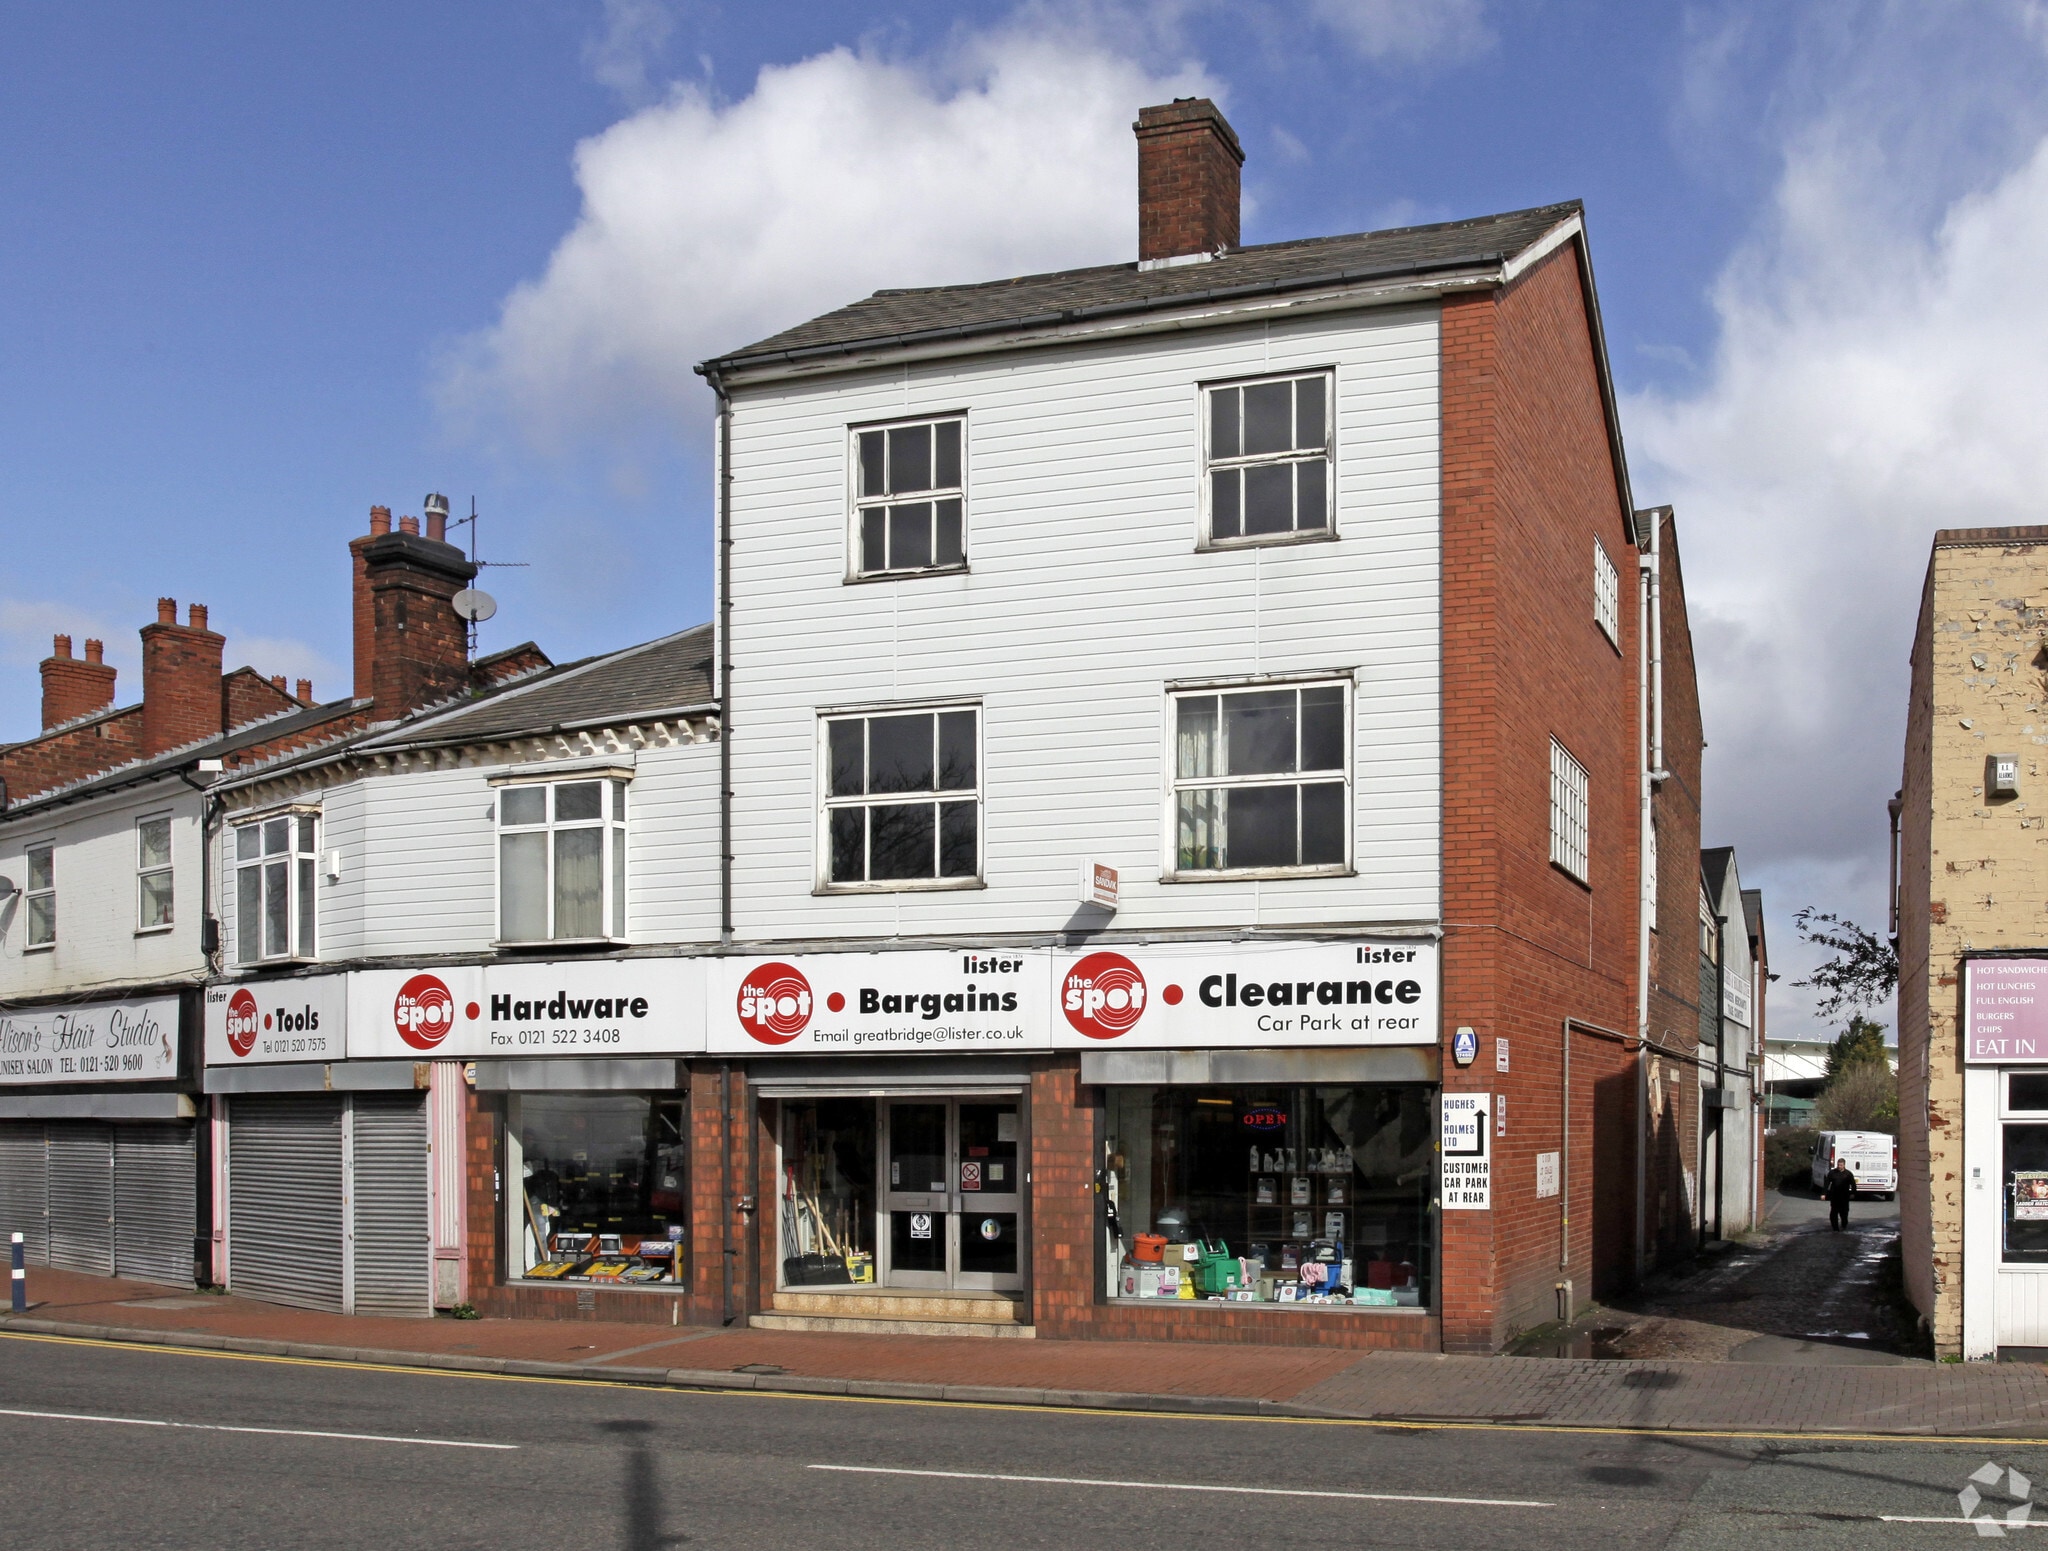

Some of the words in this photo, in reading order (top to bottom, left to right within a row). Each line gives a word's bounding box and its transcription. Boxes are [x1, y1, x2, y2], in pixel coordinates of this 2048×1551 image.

[1356, 946, 1417, 964] lister
[963, 955, 1023, 974] lister
[1976, 966, 1995, 974] HOT
[1997, 966, 2048, 974] SANDWICHE
[1067, 975, 1093, 989] the
[1976, 983, 1995, 991] HOT
[1997, 982, 2036, 990] LUNCHES
[206, 990, 227, 1003] lister
[742, 984, 764, 997] the
[1199, 973, 1421, 1008] Clearance
[399, 994, 415, 1006] the
[491, 991, 649, 1021] Hardware
[859, 984, 1018, 1020] Bargains
[1065, 982, 1144, 1018] spot
[1976, 997, 1995, 1005] FULL
[1998, 997, 2034, 1005] ENGLISH
[228, 1006, 239, 1018] the
[740, 991, 811, 1025] spot
[276, 1004, 319, 1032] Tools
[396, 1000, 452, 1031] spot
[1257, 1015, 1293, 1032] Car
[1300, 1013, 1342, 1031] Park
[1350, 1014, 1370, 1030] at
[1378, 1015, 1420, 1030] rear
[1976, 1012, 2015, 1020] BURGERS
[52, 1012, 95, 1052] Hair
[106, 1009, 159, 1048] Studio
[227, 1011, 258, 1040] spot
[1977, 1025, 2002, 1034] CHIPS
[490, 1031, 513, 1045] Fax
[519, 1030, 545, 1044] 0121
[552, 1030, 577, 1044] 522
[583, 1029, 621, 1043] 3408
[813, 1029, 849, 1042] Email
[853, 1026, 1023, 1044] greatbridge@lister.co.uk
[263, 1040, 273, 1053] Tel
[274, 1039, 290, 1053] 0121
[291, 1039, 306, 1052] 520
[308, 1037, 327, 1051] 7575
[1976, 1039, 2009, 1055] EAT
[2015, 1038, 2036, 1054] IN
[27, 1058, 53, 1074] SALON
[60, 1057, 77, 1073] TEL:
[123, 1054, 143, 1071] 9600
[1443, 1099, 1476, 1109] HUGHES
[1243, 1114, 1287, 1125] OPEN
[1444, 1112, 1450, 1122] &
[1443, 1124, 1476, 1134] HOLMES
[1443, 1137, 1458, 1147] LTD
[1443, 1162, 1489, 1174] CUSTOMER
[1444, 1177, 1461, 1188] CAR
[1466, 1177, 1488, 1188] PARK
[1448, 1192, 1458, 1203] AT
[1463, 1192, 1484, 1203] REAR
